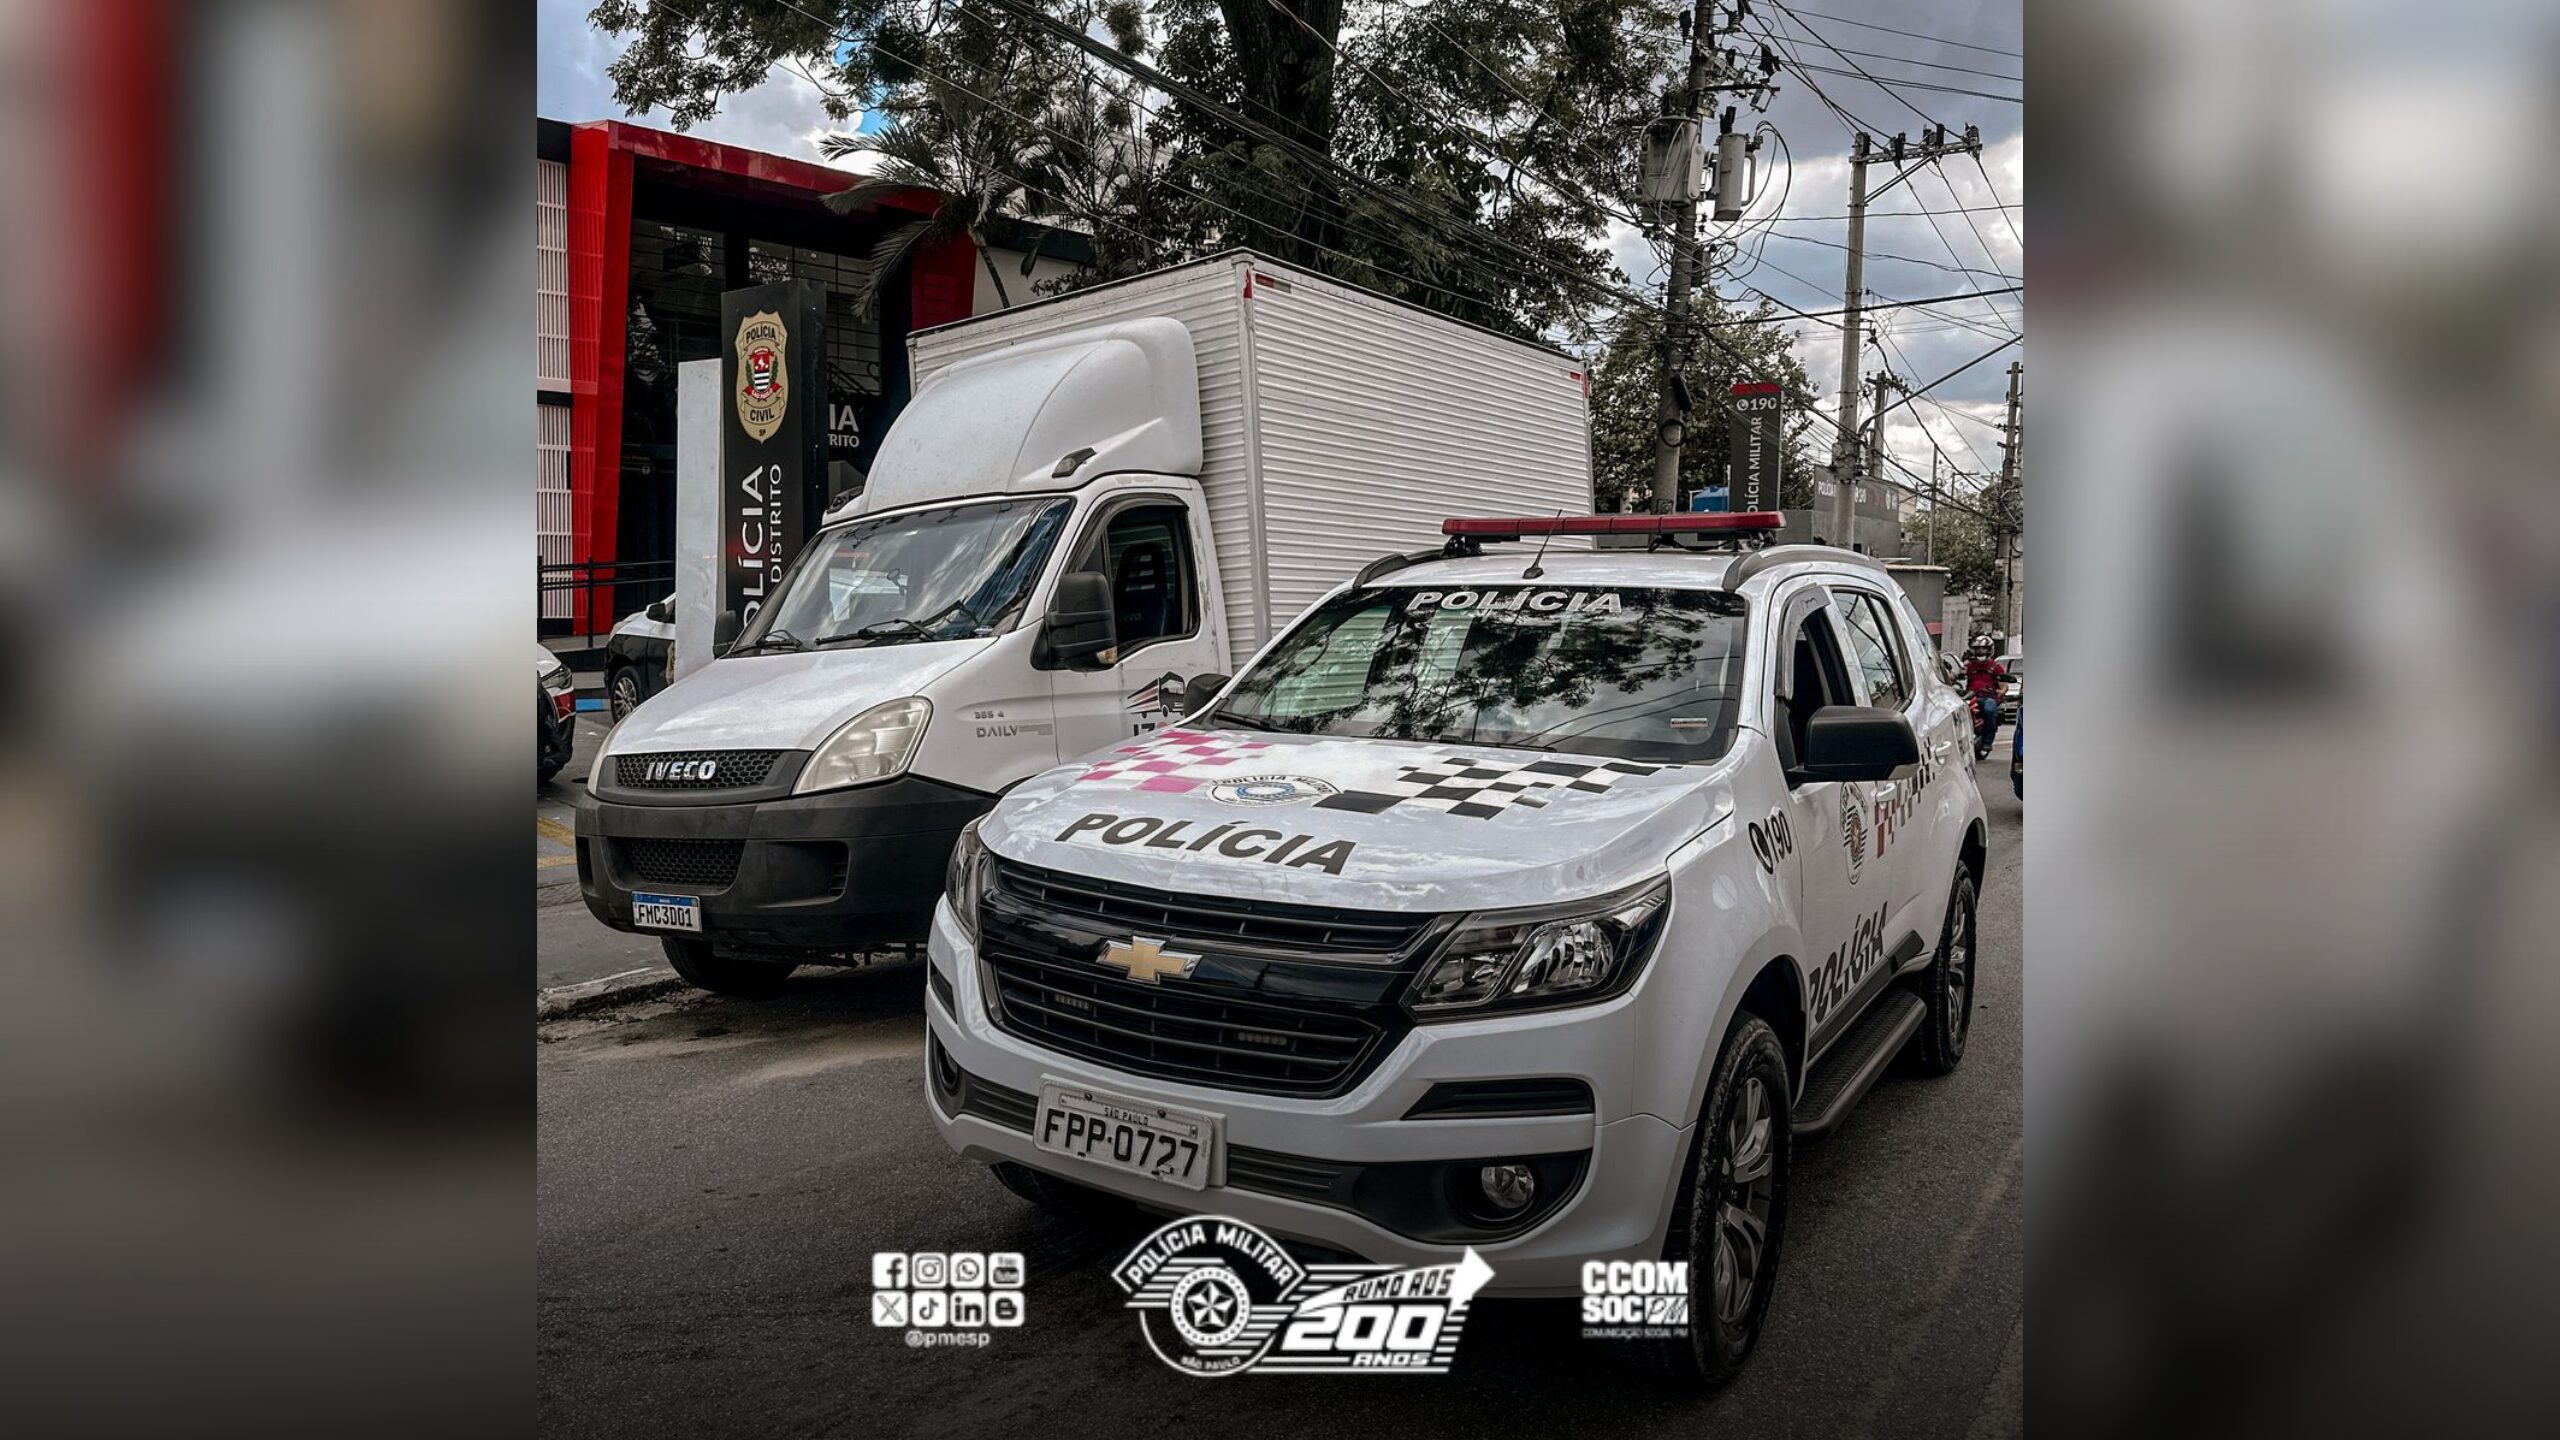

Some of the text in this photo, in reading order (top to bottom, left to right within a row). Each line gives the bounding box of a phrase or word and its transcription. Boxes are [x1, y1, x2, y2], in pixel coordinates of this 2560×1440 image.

[746, 326, 777, 342] POLÍCIA
[750, 409, 775, 422] CIVIL
[1750, 398, 1777, 411] 190
[1744, 416, 1762, 512] OLÍCIA MILITAR
[769, 463, 783, 583] DISTRITO
[737, 465, 763, 628] OLÍCIA
[1404, 587, 1622, 613] POLÍCIA
[645, 761, 716, 780] IVECO
[1054, 813, 1357, 875] POLÍCIA
[1764, 810, 1792, 864] 190
[638, 904, 692, 927] FMC3D01
[1809, 901, 1888, 1024] POLÍCIA
